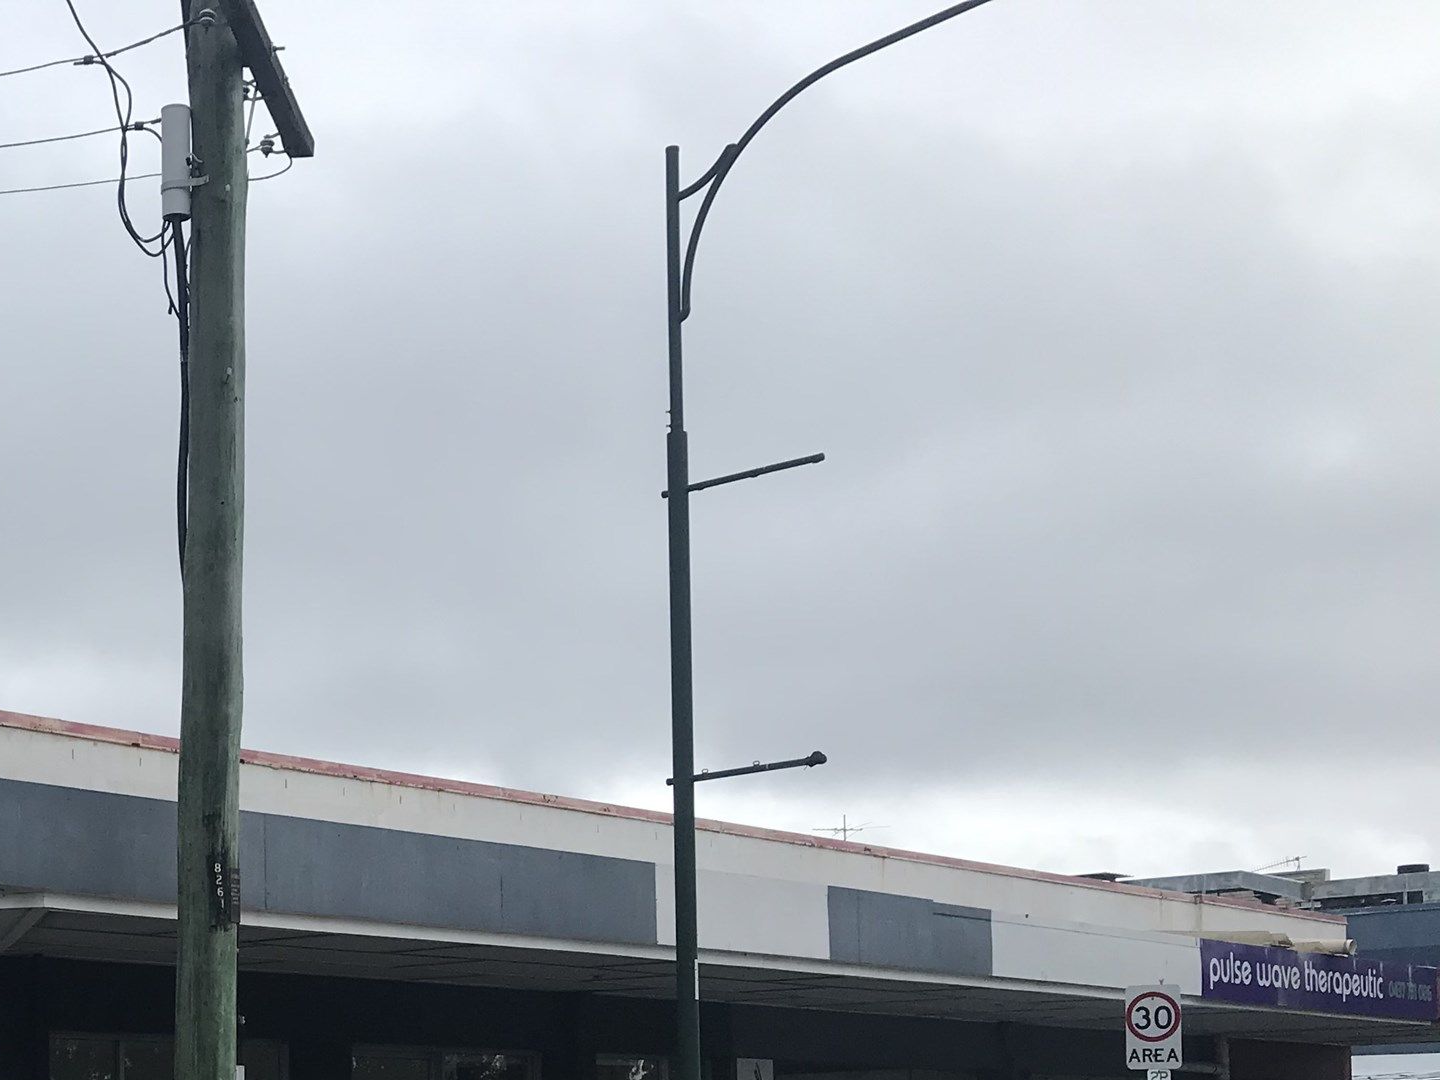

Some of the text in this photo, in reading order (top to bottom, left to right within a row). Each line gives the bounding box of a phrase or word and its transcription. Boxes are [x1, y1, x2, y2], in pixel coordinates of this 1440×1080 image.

[214, 862, 225, 909] 8261
[1210, 951, 1252, 990] pulse
[1256, 961, 1301, 990] wave
[1304, 960, 1384, 1002] therapeutic
[1134, 1005, 1172, 1030] 30
[1128, 1048, 1179, 1063] AREA
